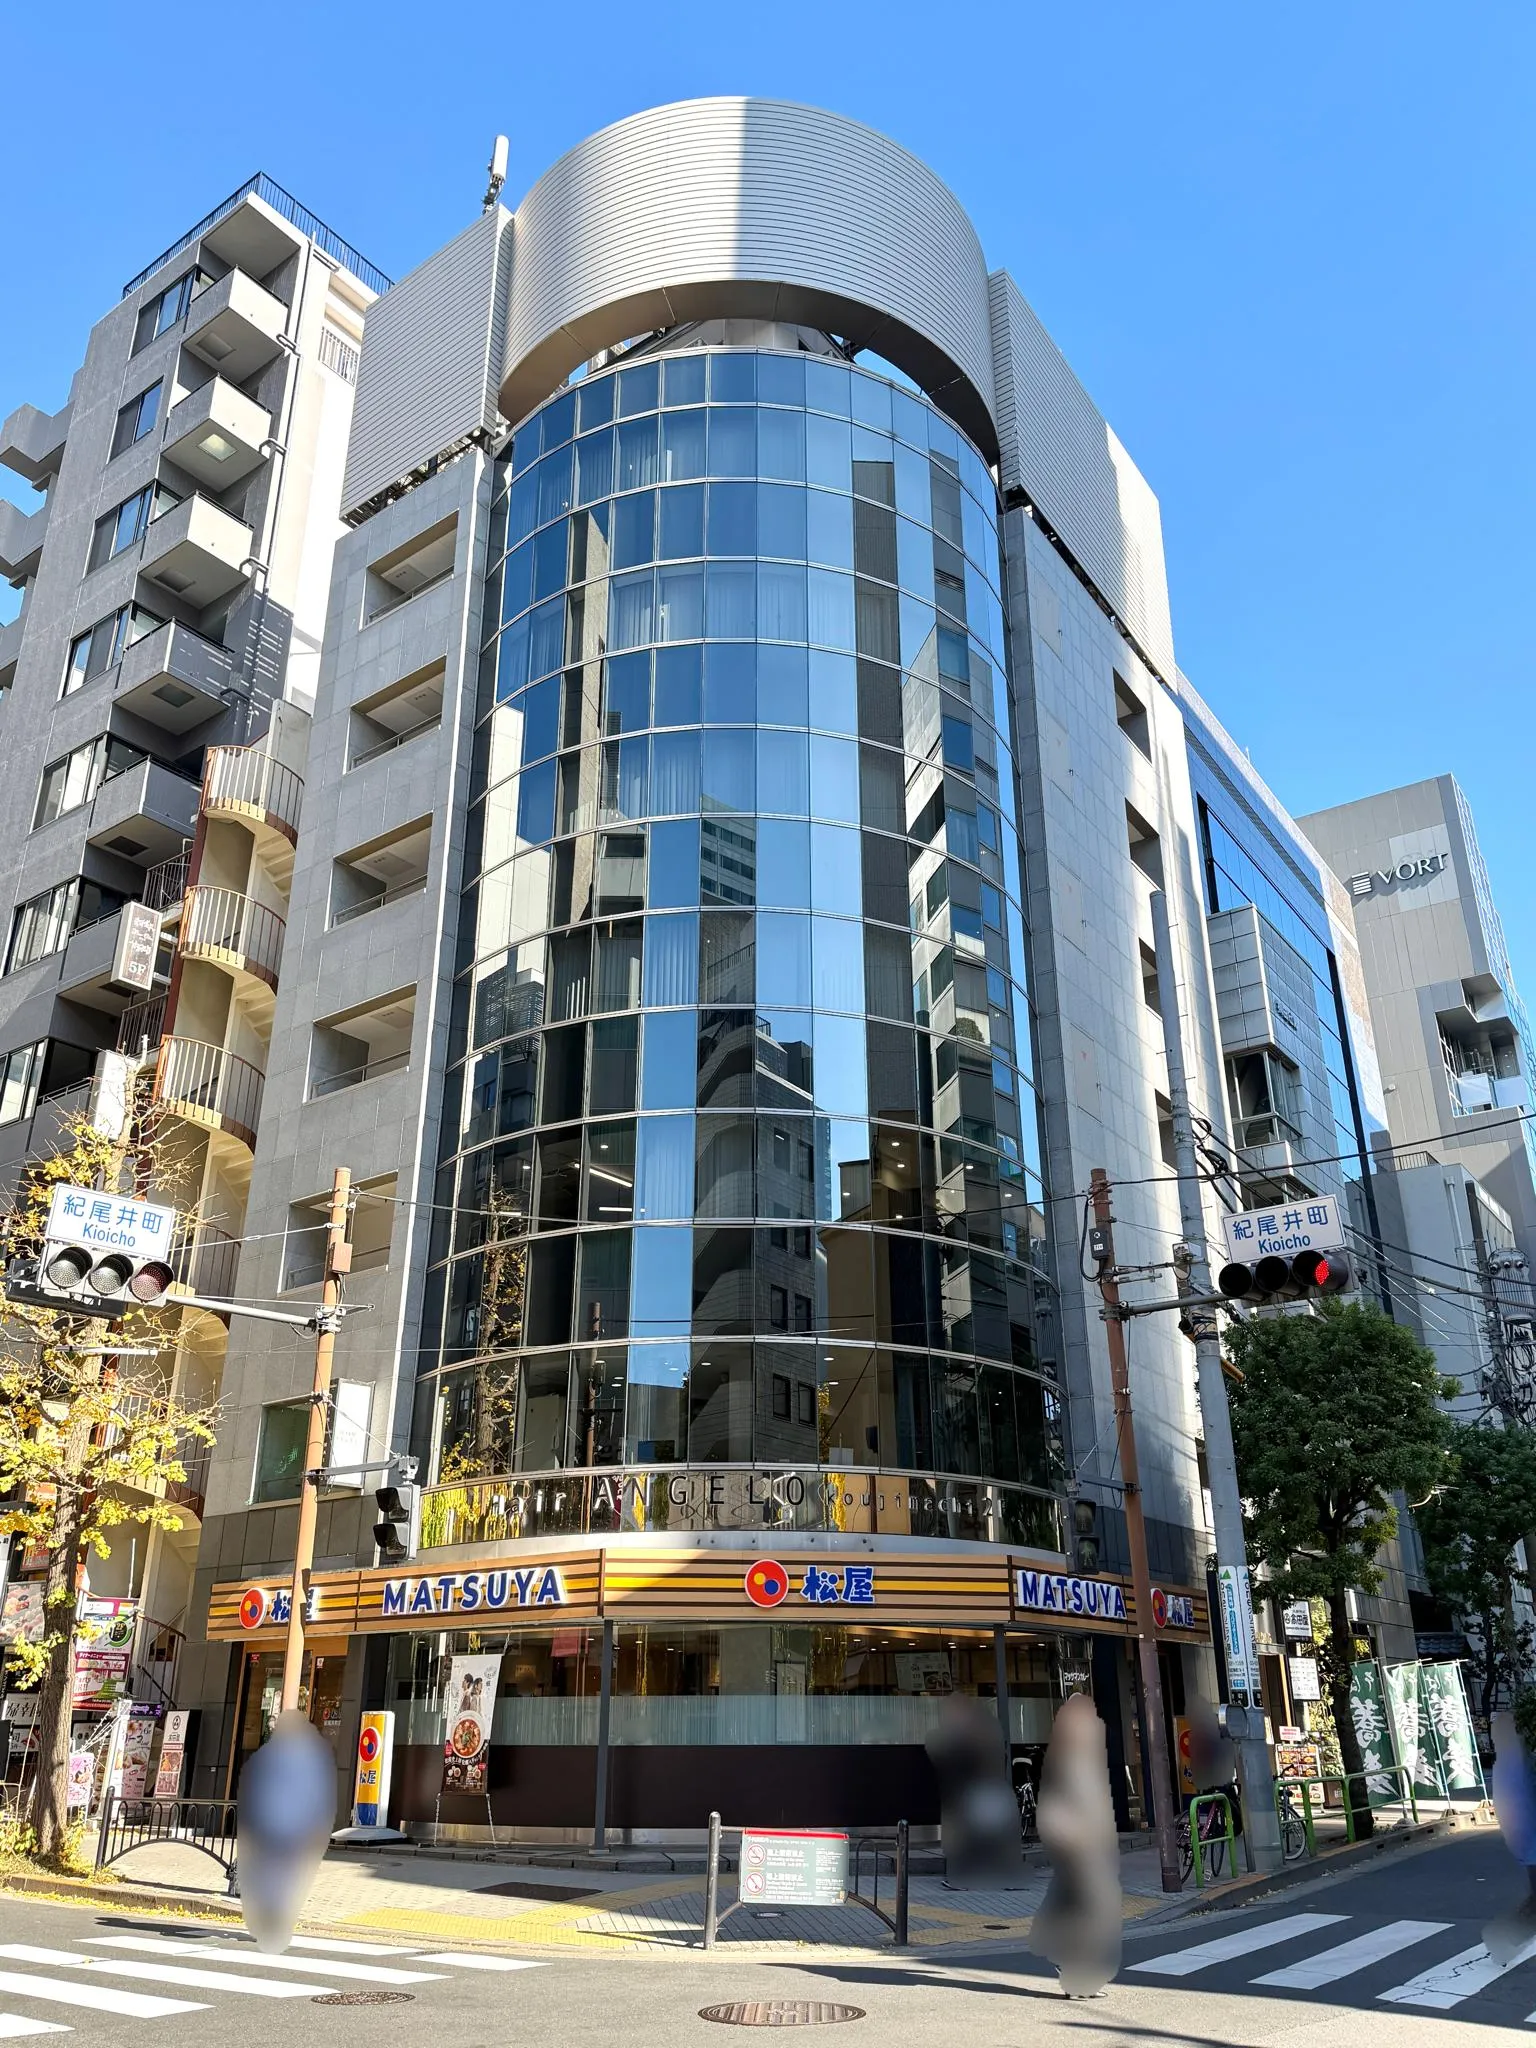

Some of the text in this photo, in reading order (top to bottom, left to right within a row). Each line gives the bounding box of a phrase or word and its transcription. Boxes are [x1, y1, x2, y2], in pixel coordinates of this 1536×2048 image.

[1378, 853, 1448, 884] VORT
[64, 1194, 163, 1234] 紀尾井町
[1232, 1205, 1328, 1240] 紀尾井町
[83, 1223, 136, 1247] Kioicho
[1258, 1234, 1311, 1254] Kioicho
[594, 1475, 804, 1510] ANGELO
[383, 1568, 563, 1615] MATSUYA
[801, 1565, 875, 1603] 松屋
[1019, 1571, 1127, 1619] MATSUYA
